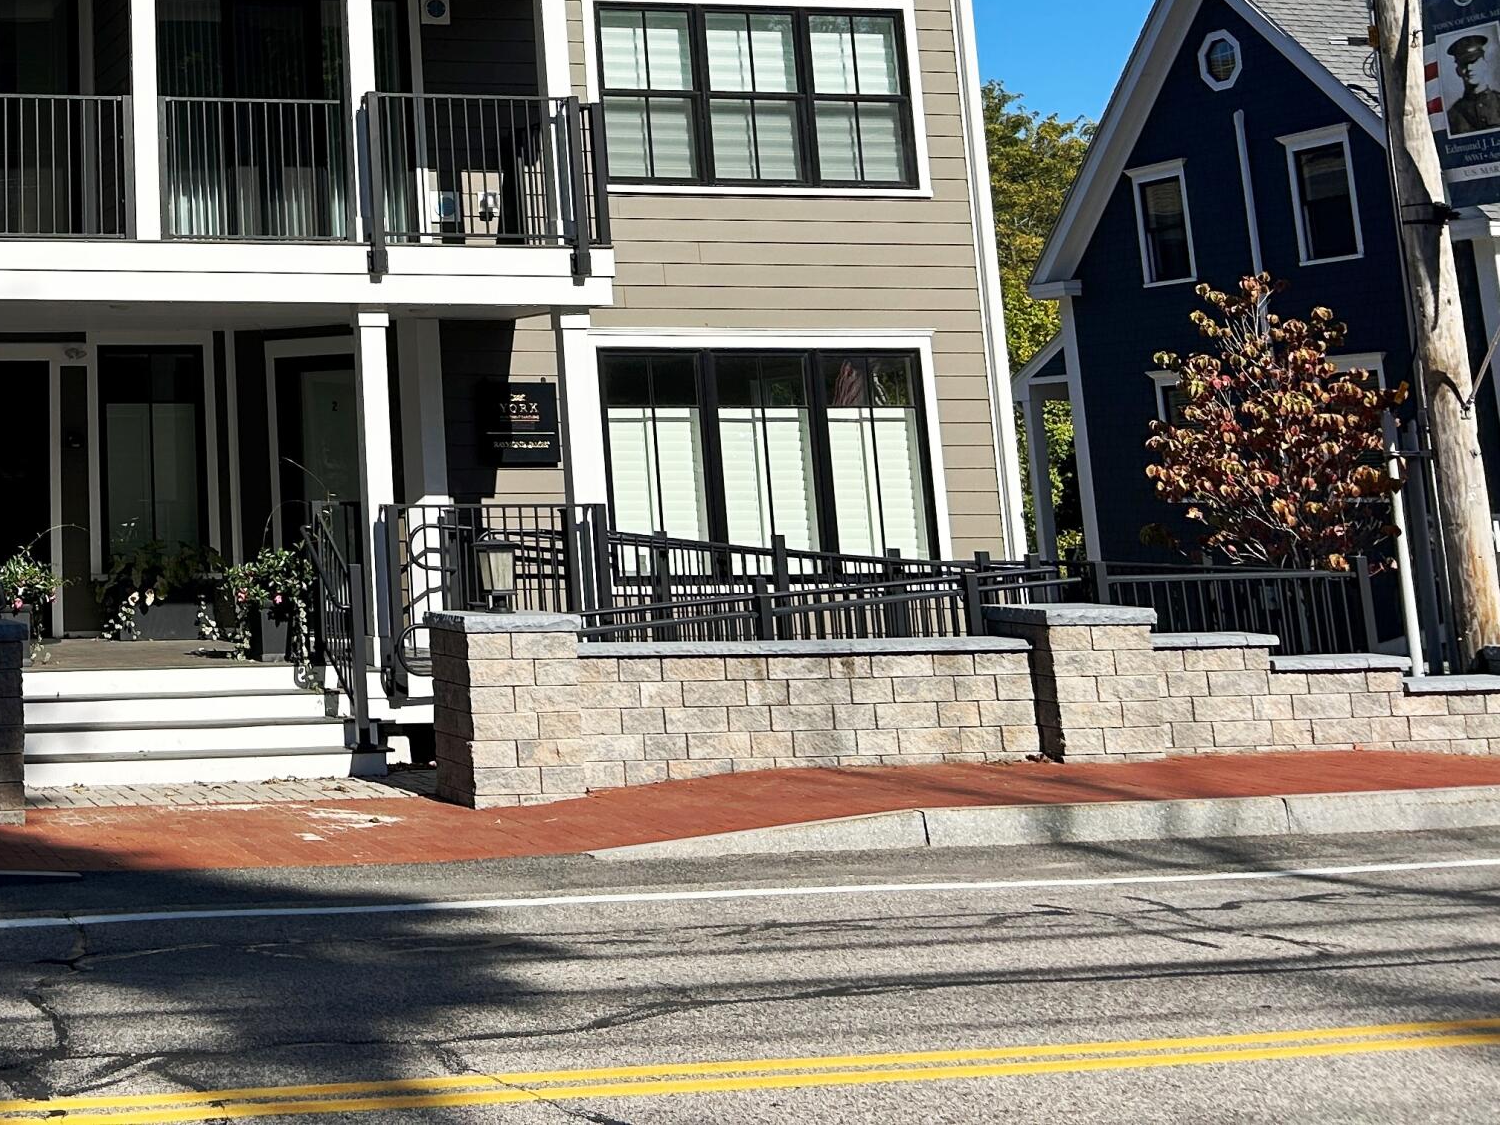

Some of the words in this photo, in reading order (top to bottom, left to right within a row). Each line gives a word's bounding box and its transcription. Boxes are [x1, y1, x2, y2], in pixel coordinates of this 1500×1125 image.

[1444, 139, 1481, 154] Edmund
[1481, 138, 1489, 152] J.
[332, 401, 338, 412] 2
[499, 402, 539, 414] YORK
